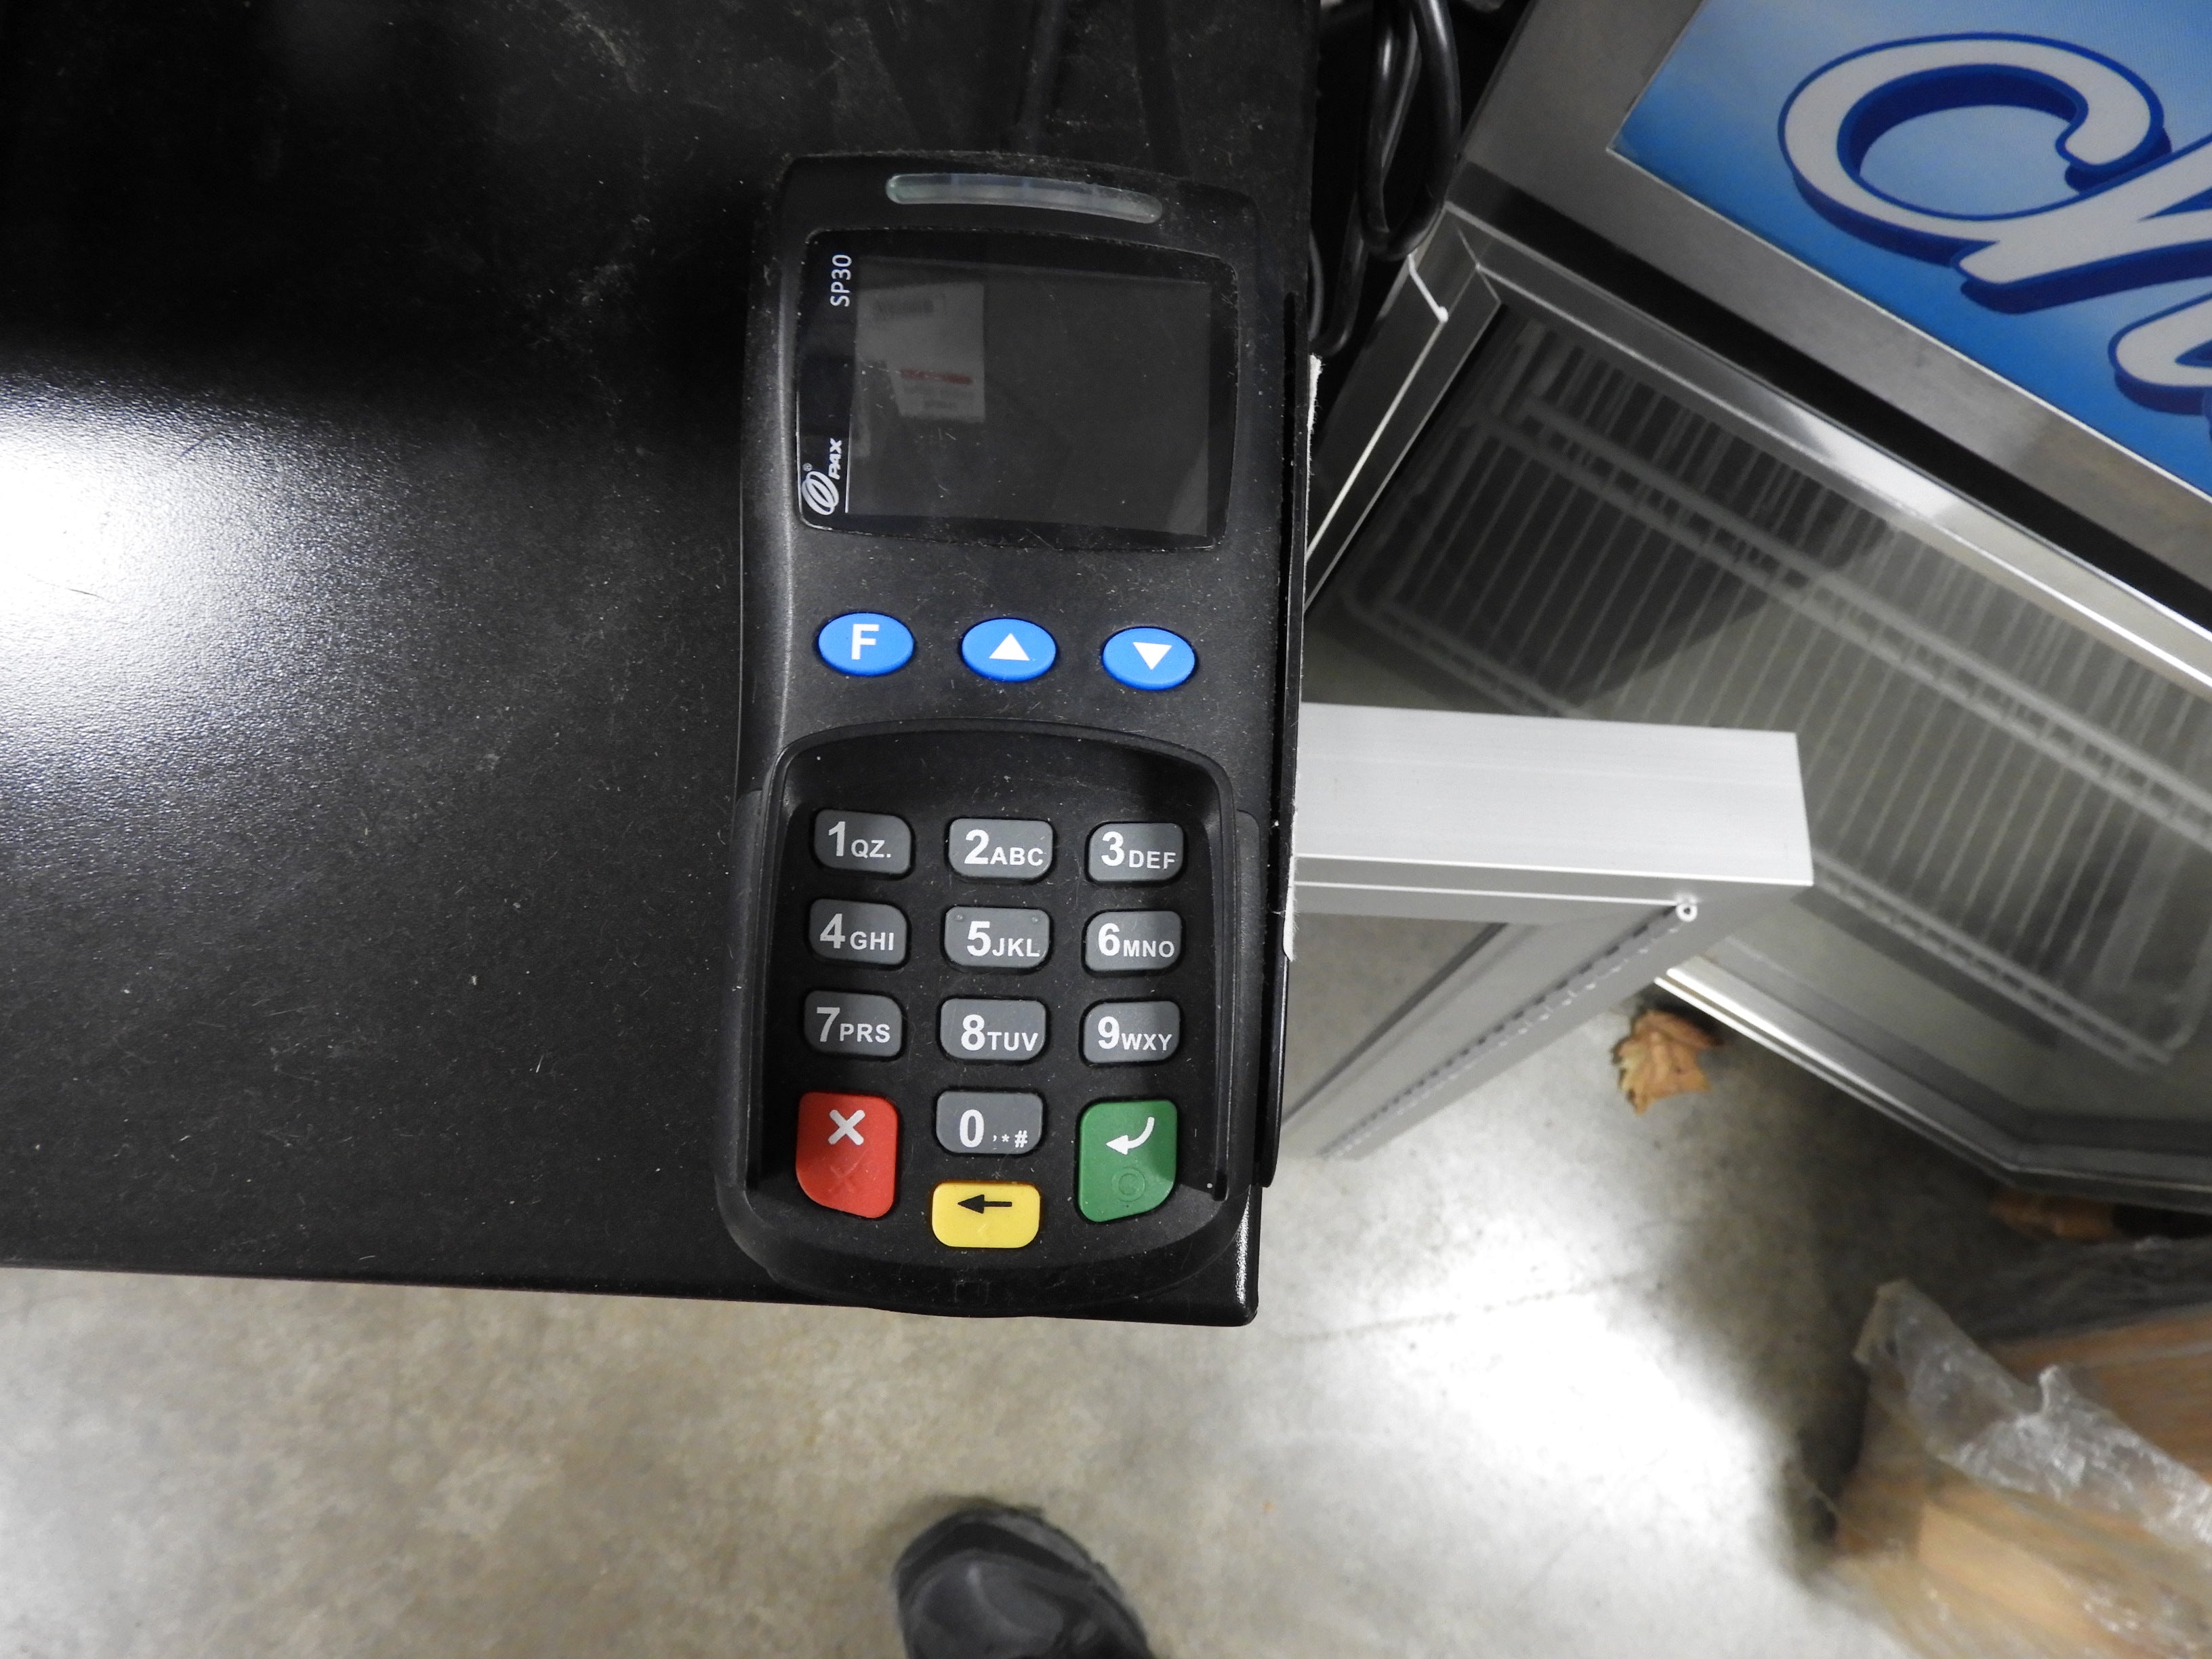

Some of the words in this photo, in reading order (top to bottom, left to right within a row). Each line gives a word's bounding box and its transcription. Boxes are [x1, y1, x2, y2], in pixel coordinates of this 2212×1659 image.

[830, 254, 852, 307] SP30
[828, 438, 842, 480] PAX
[851, 623, 880, 660] F
